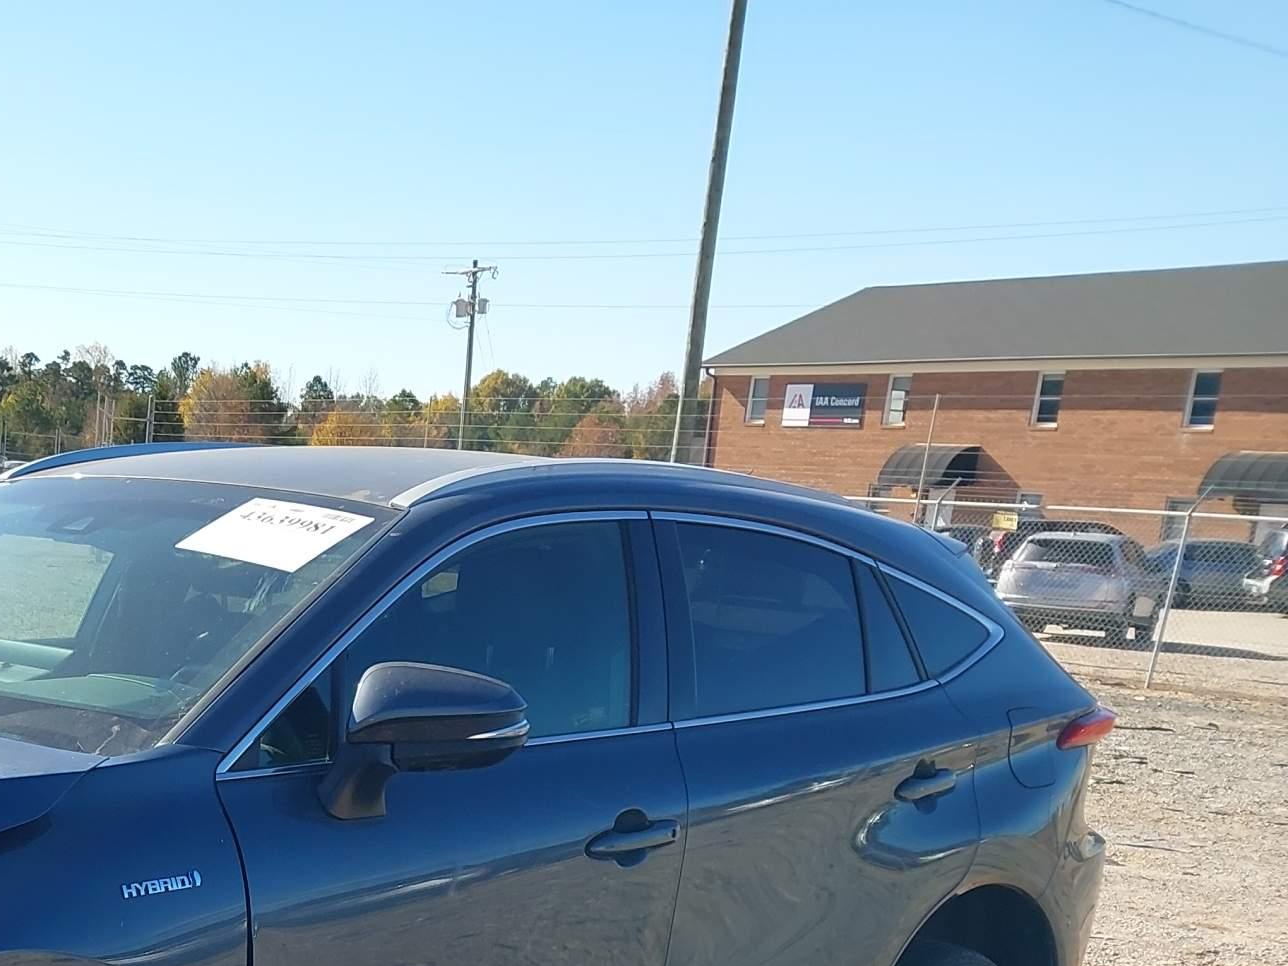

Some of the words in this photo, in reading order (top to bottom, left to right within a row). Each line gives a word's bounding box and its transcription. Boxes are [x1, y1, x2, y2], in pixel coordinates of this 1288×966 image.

[830, 396, 860, 407] Concord
[240, 510, 337, 535] 43639981
[122, 873, 192, 899] HYBRID
